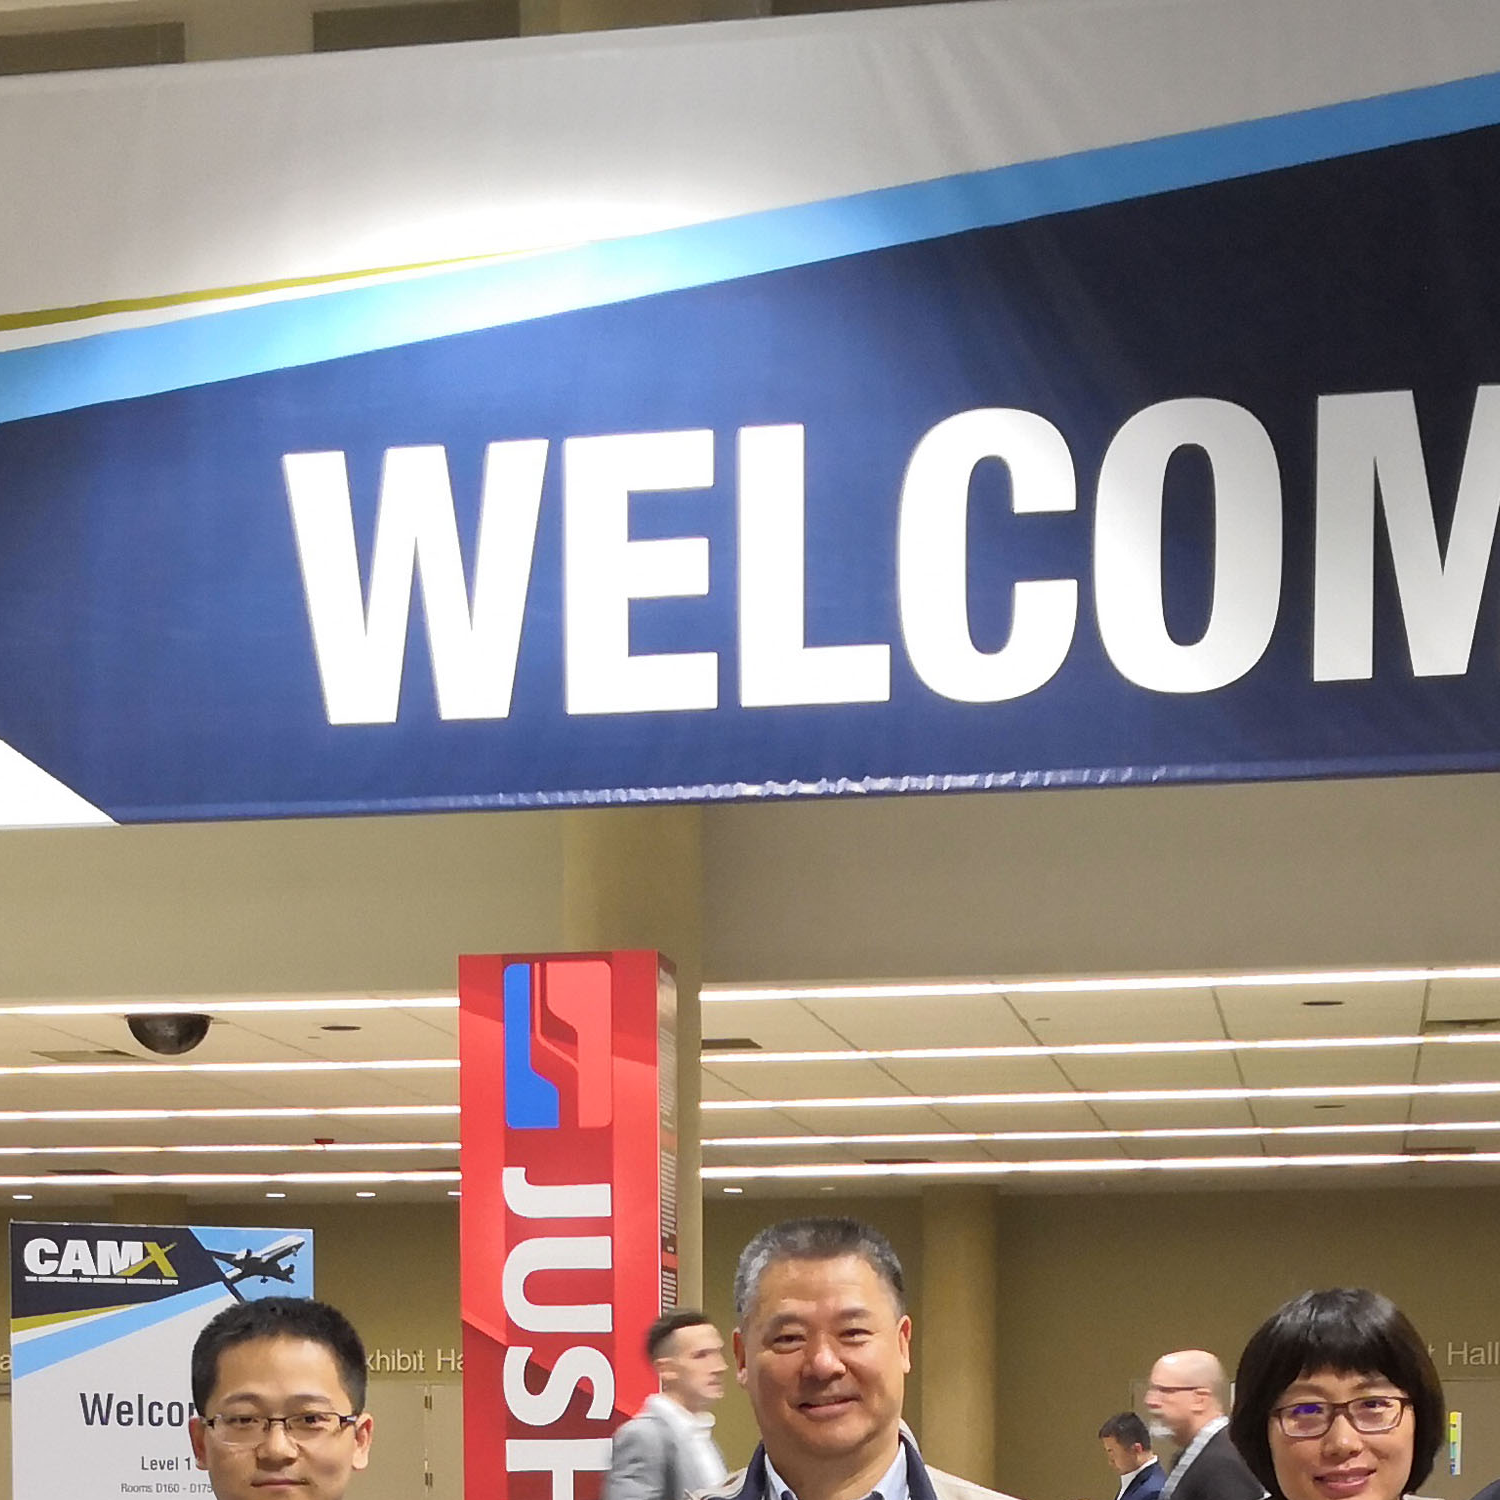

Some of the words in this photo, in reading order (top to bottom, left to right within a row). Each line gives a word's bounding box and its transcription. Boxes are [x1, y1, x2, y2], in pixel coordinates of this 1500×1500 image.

[23, 1237, 178, 1277] CAMX
[365, 1348, 426, 1372] xhibit
[1447, 1341, 1499, 1366] Hall
[79, 1392, 195, 1428] Welco
[141, 1455, 179, 1471] Level
[185, 1456, 191, 1471] 1
[120, 1483, 153, 1493] Rooms
[156, 1483, 180, 1493] D160
